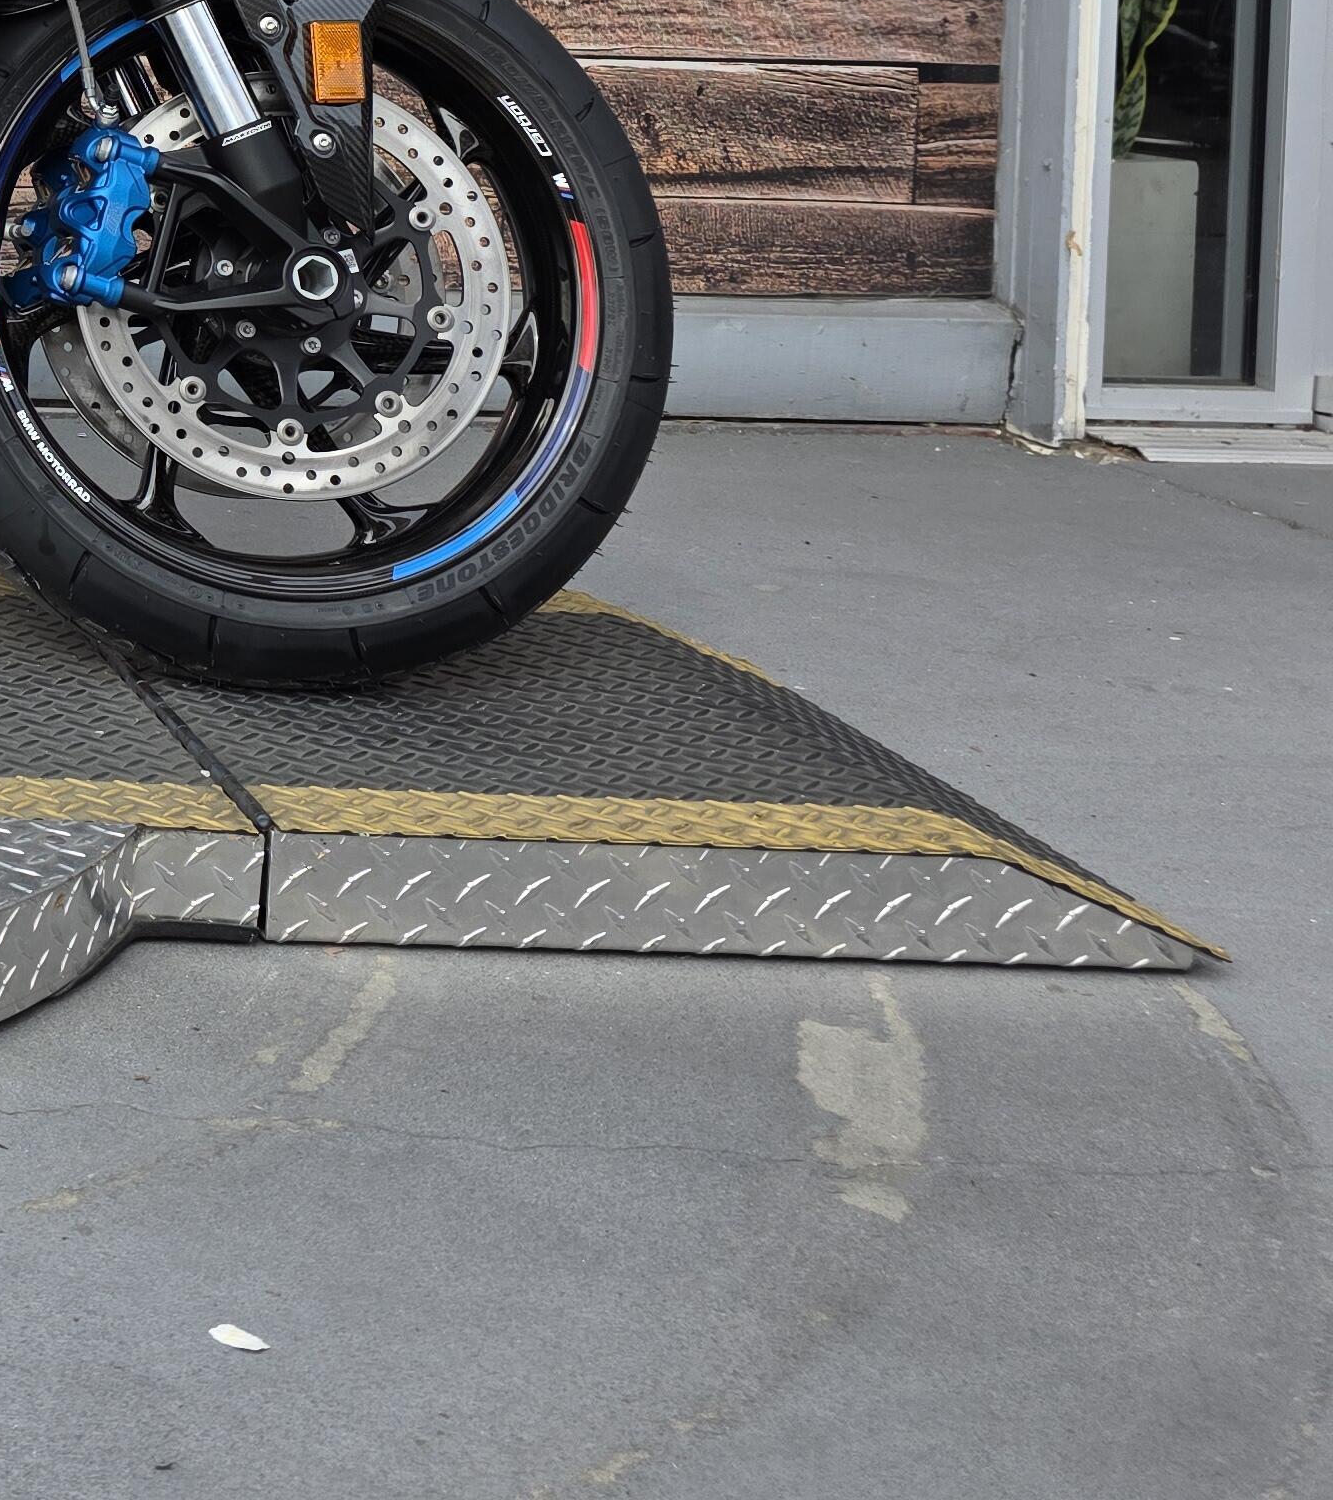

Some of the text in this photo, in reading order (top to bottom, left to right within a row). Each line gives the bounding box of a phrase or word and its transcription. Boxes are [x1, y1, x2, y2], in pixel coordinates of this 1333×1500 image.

[496, 93, 553, 157] Carbon
[16, 409, 41, 441] BMW
[36, 441, 91, 503] MOTORRAD
[416, 440, 595, 599] BRIDGESTONE
